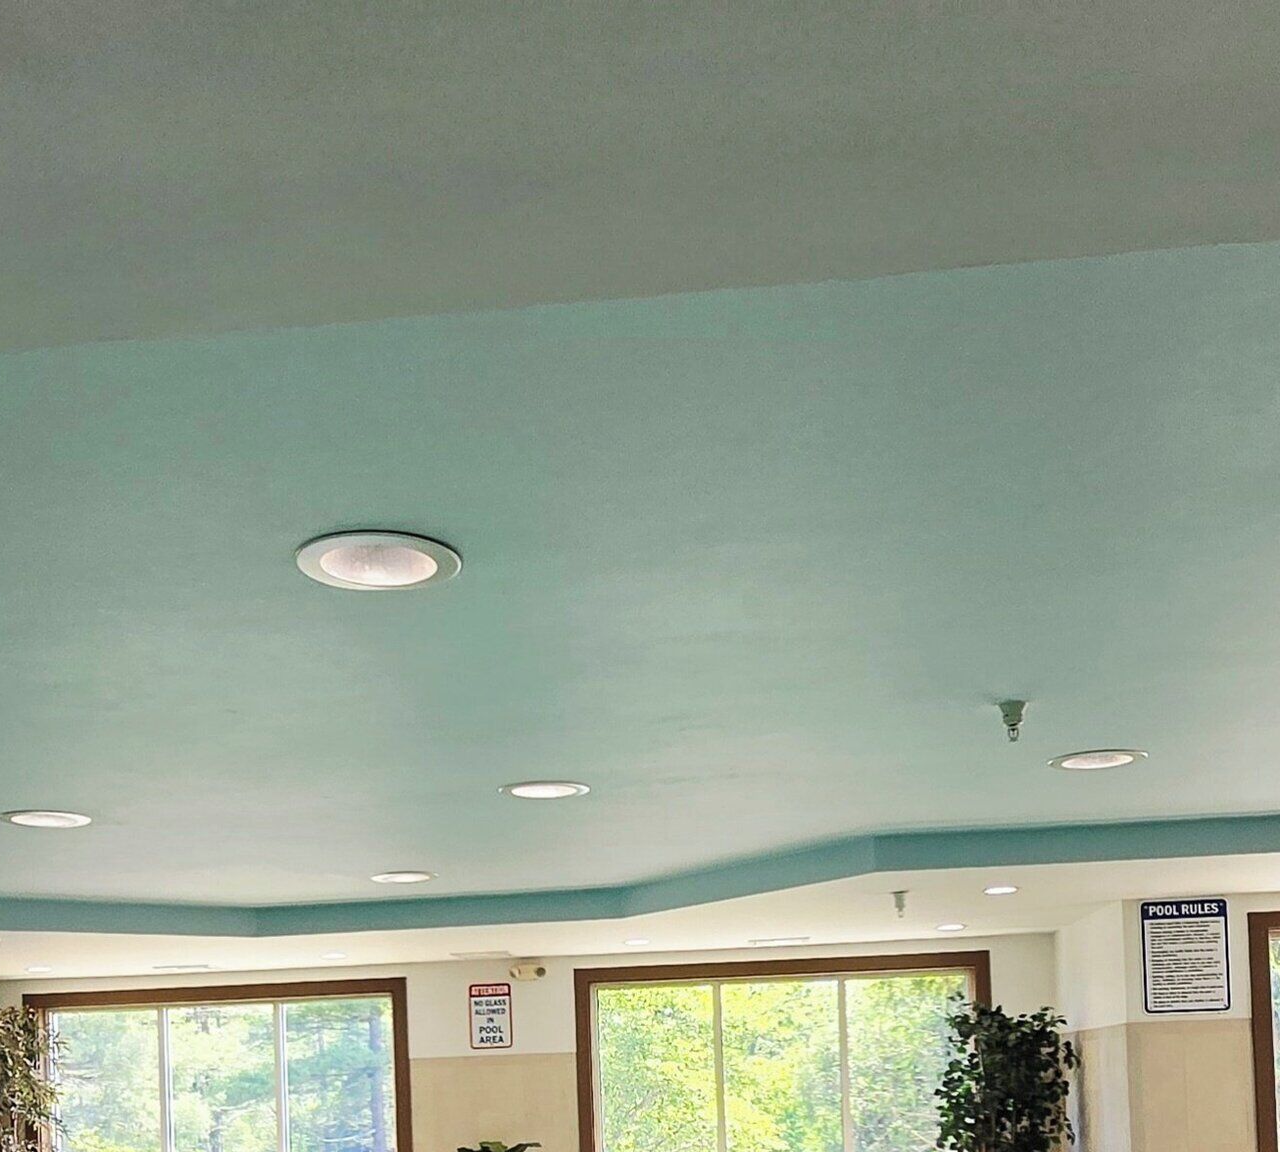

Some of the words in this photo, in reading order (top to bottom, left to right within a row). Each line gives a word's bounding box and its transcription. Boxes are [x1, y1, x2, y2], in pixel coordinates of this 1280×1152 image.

[1148, 905, 1179, 916] POOL
[1181, 903, 1219, 915] RULES
[479, 1026, 504, 1034] POOL
[479, 1036, 505, 1044] AREA
